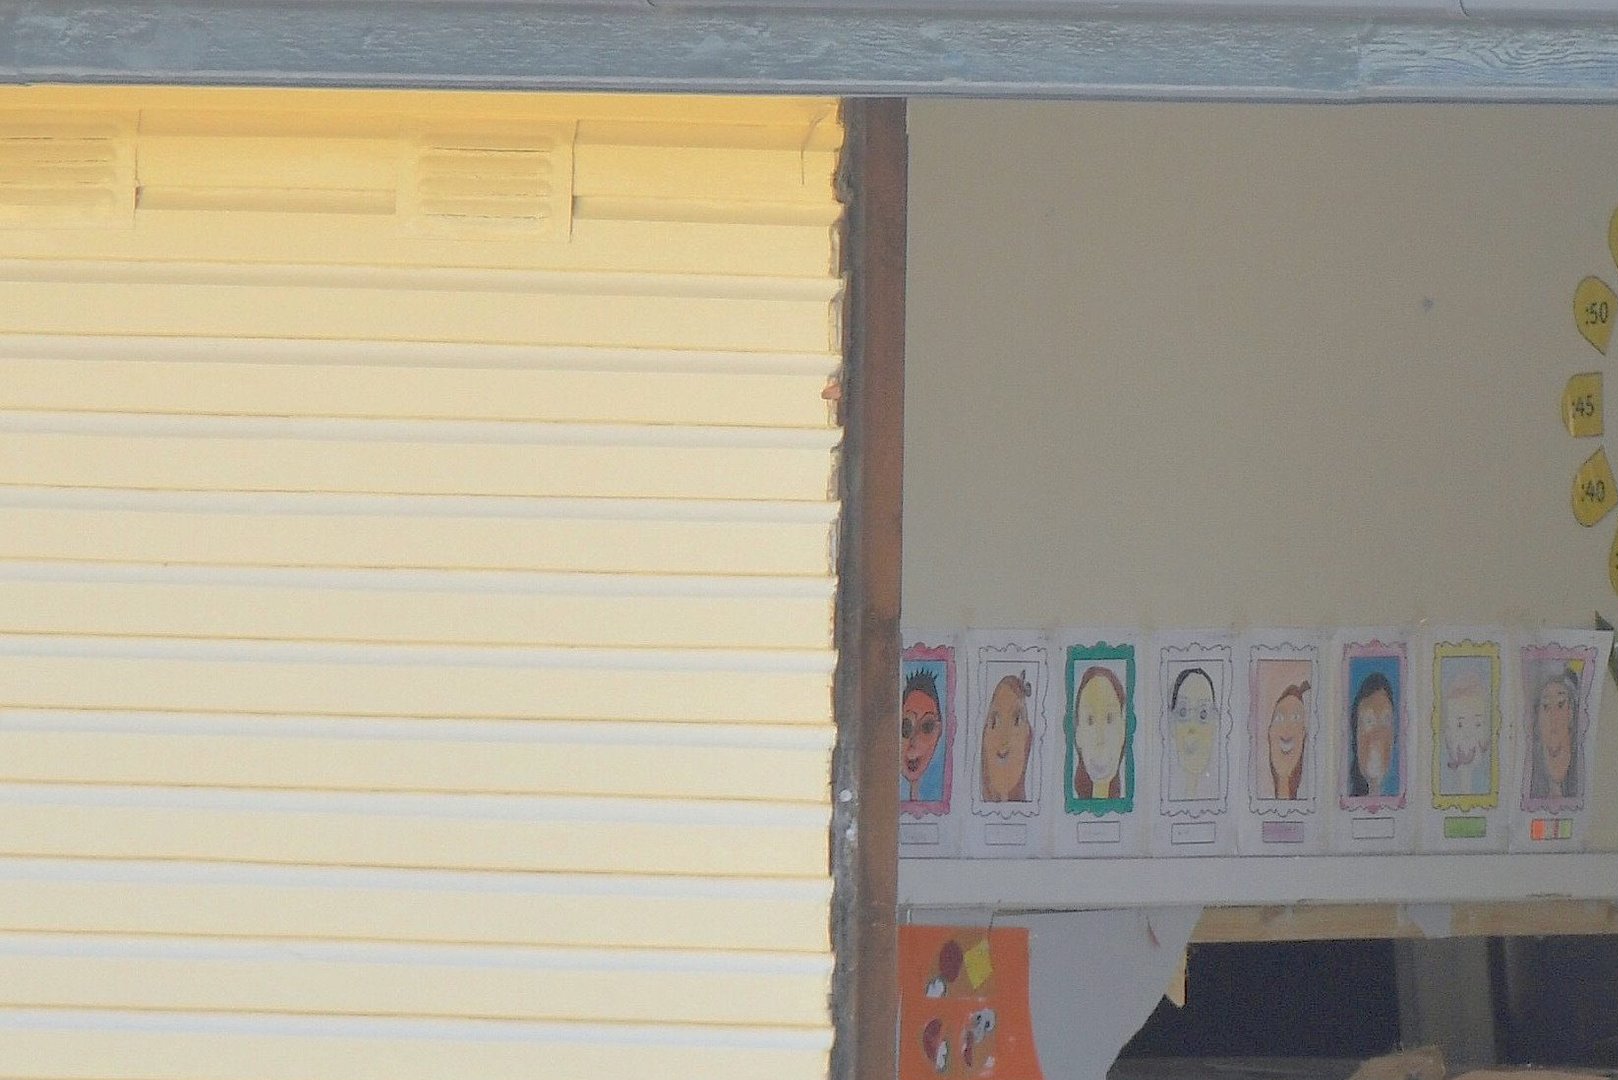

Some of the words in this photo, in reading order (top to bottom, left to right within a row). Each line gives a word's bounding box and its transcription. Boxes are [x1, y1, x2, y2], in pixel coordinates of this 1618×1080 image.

[1585, 301, 1609, 325] :50
[1571, 394, 1595, 417] :45
[1581, 479, 1606, 503] :40
